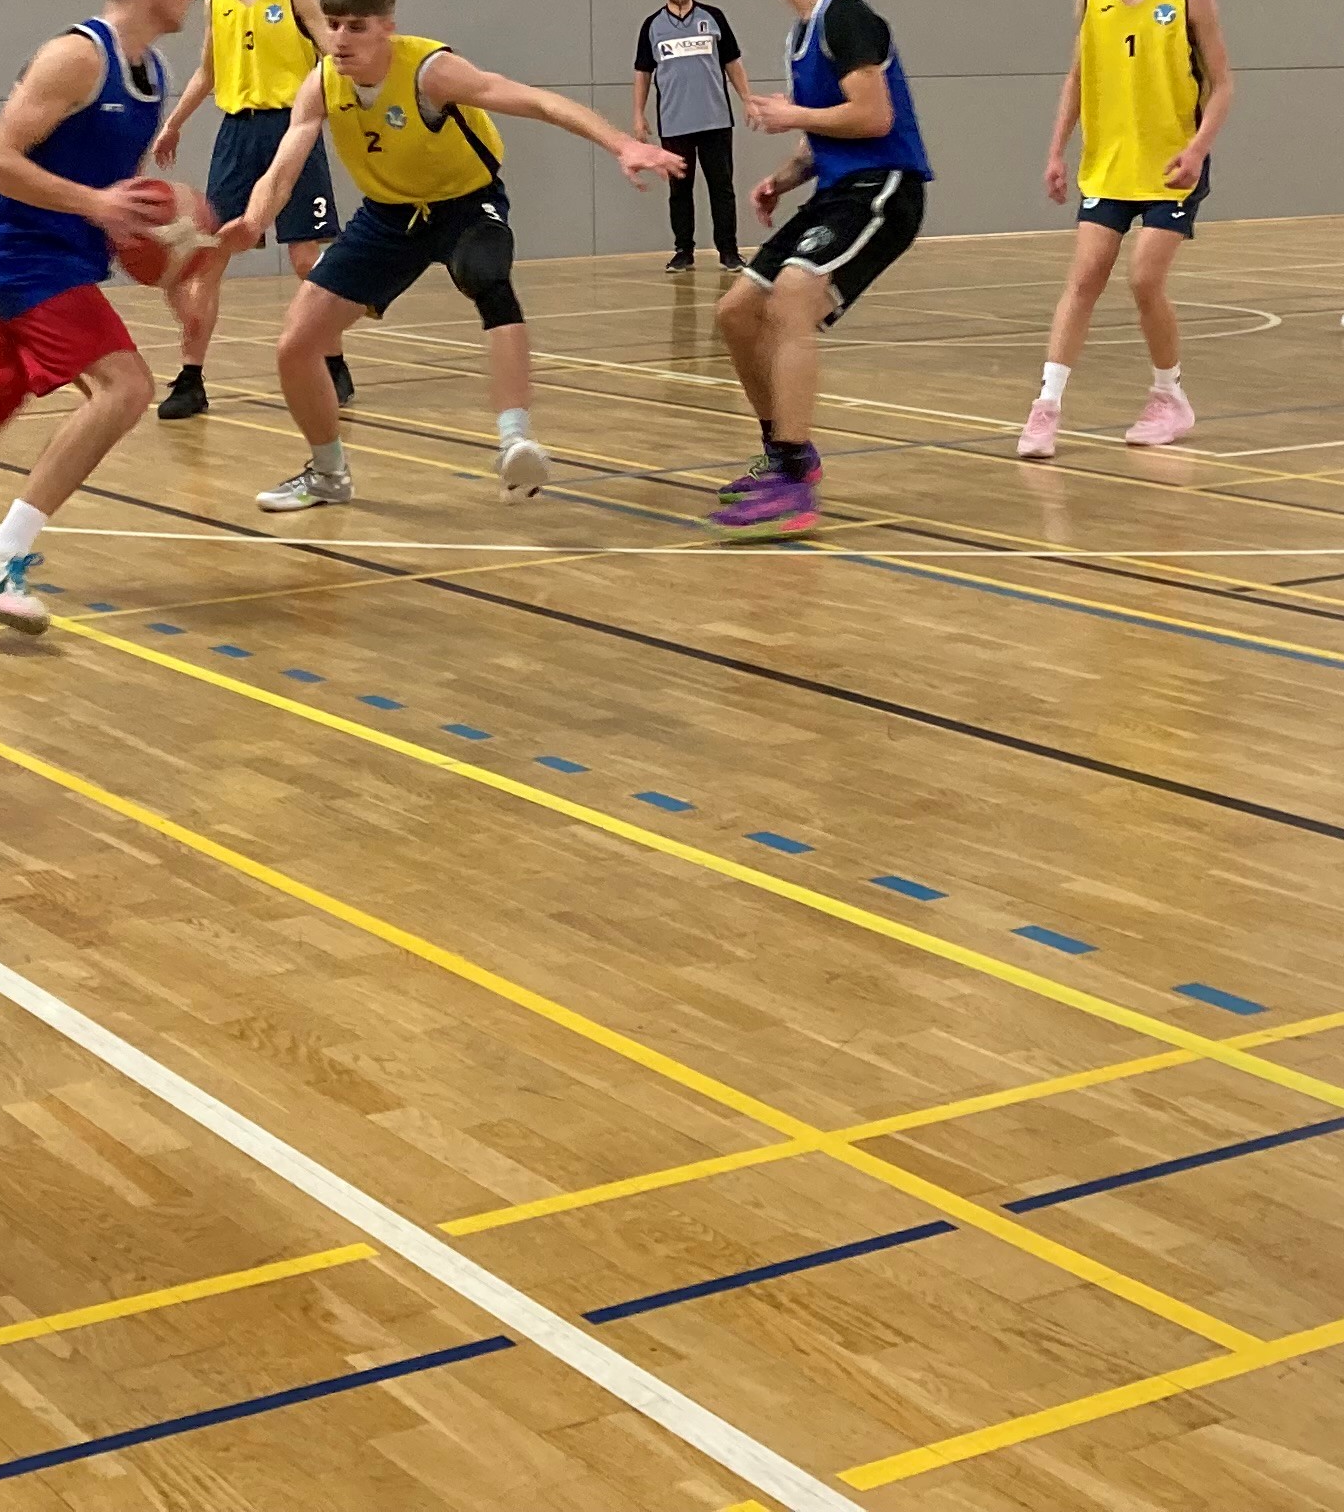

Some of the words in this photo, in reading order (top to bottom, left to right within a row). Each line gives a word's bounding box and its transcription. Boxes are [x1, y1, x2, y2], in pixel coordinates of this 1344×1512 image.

[243, 30, 255, 50] 3
[1124, 34, 1136, 57] 1
[364, 131, 383, 153] 2
[312, 196, 327, 218] 3
